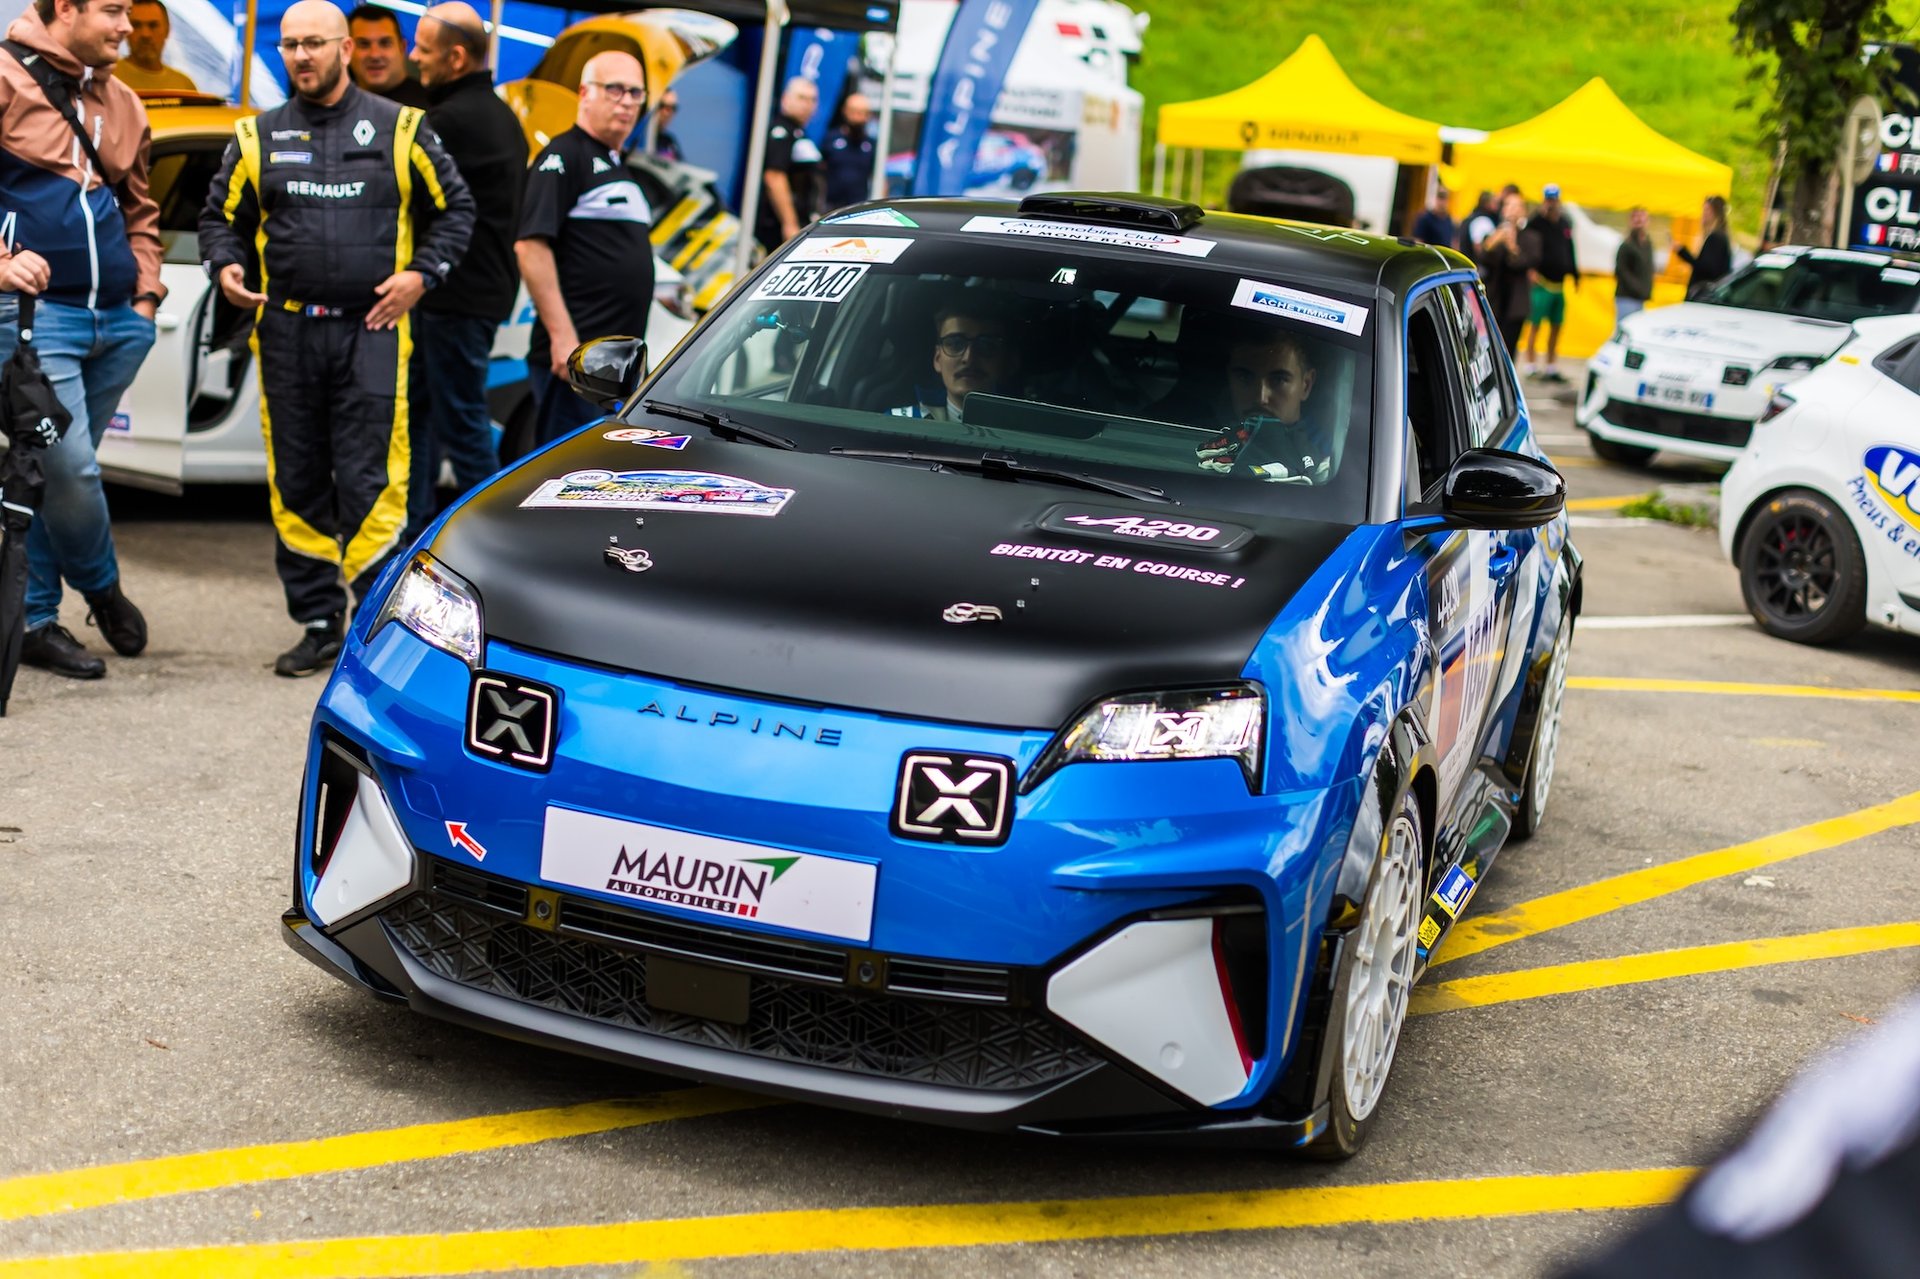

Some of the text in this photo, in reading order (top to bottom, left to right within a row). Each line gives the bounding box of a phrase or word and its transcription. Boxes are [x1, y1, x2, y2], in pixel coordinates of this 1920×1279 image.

[937, 1, 1013, 169] ALPINE
[286, 181, 366, 198] RENAULT
[1012, 220, 1165, 243] Automobile Club
[1038, 231, 1160, 249] MONT-BLANC
[761, 266, 862, 298] eDEMO
[1258, 297, 1339, 321] ACHETIMMO
[1846, 476, 1889, 529] Pneus
[1887, 523, 1905, 543] &
[990, 543, 1246, 589] BIENTÔT EN COURSE !
[638, 700, 843, 747] ALPINE
[611, 844, 768, 904] MAURIN
[611, 880, 732, 912] AUTOMOBILES
